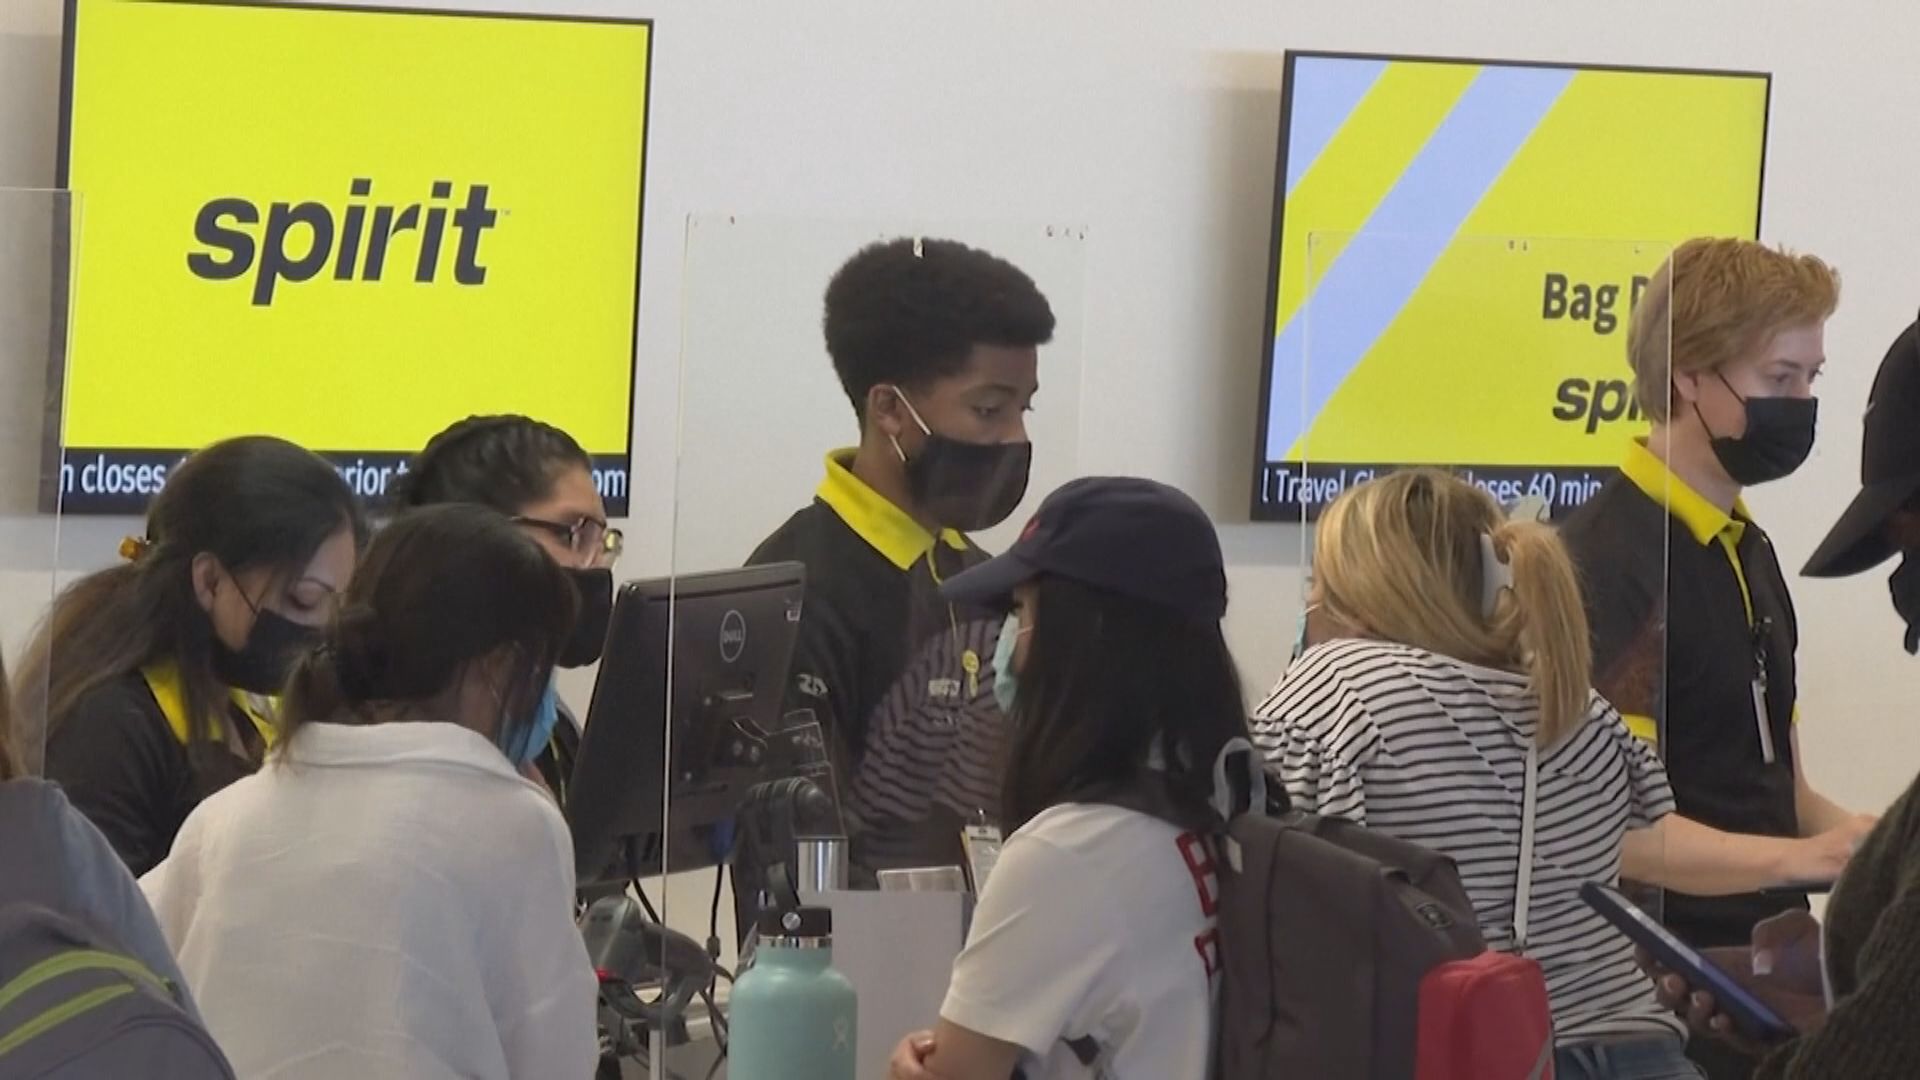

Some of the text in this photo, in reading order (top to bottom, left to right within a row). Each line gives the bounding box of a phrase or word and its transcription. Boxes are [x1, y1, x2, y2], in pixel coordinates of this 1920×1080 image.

[187, 178, 498, 306] spirit
[1543, 273, 1620, 335] Bag
[82, 454, 167, 494] closes
[335, 458, 392, 495] rior
[1276, 469, 1346, 503] Travel
[1528, 472, 1556, 506] 60
